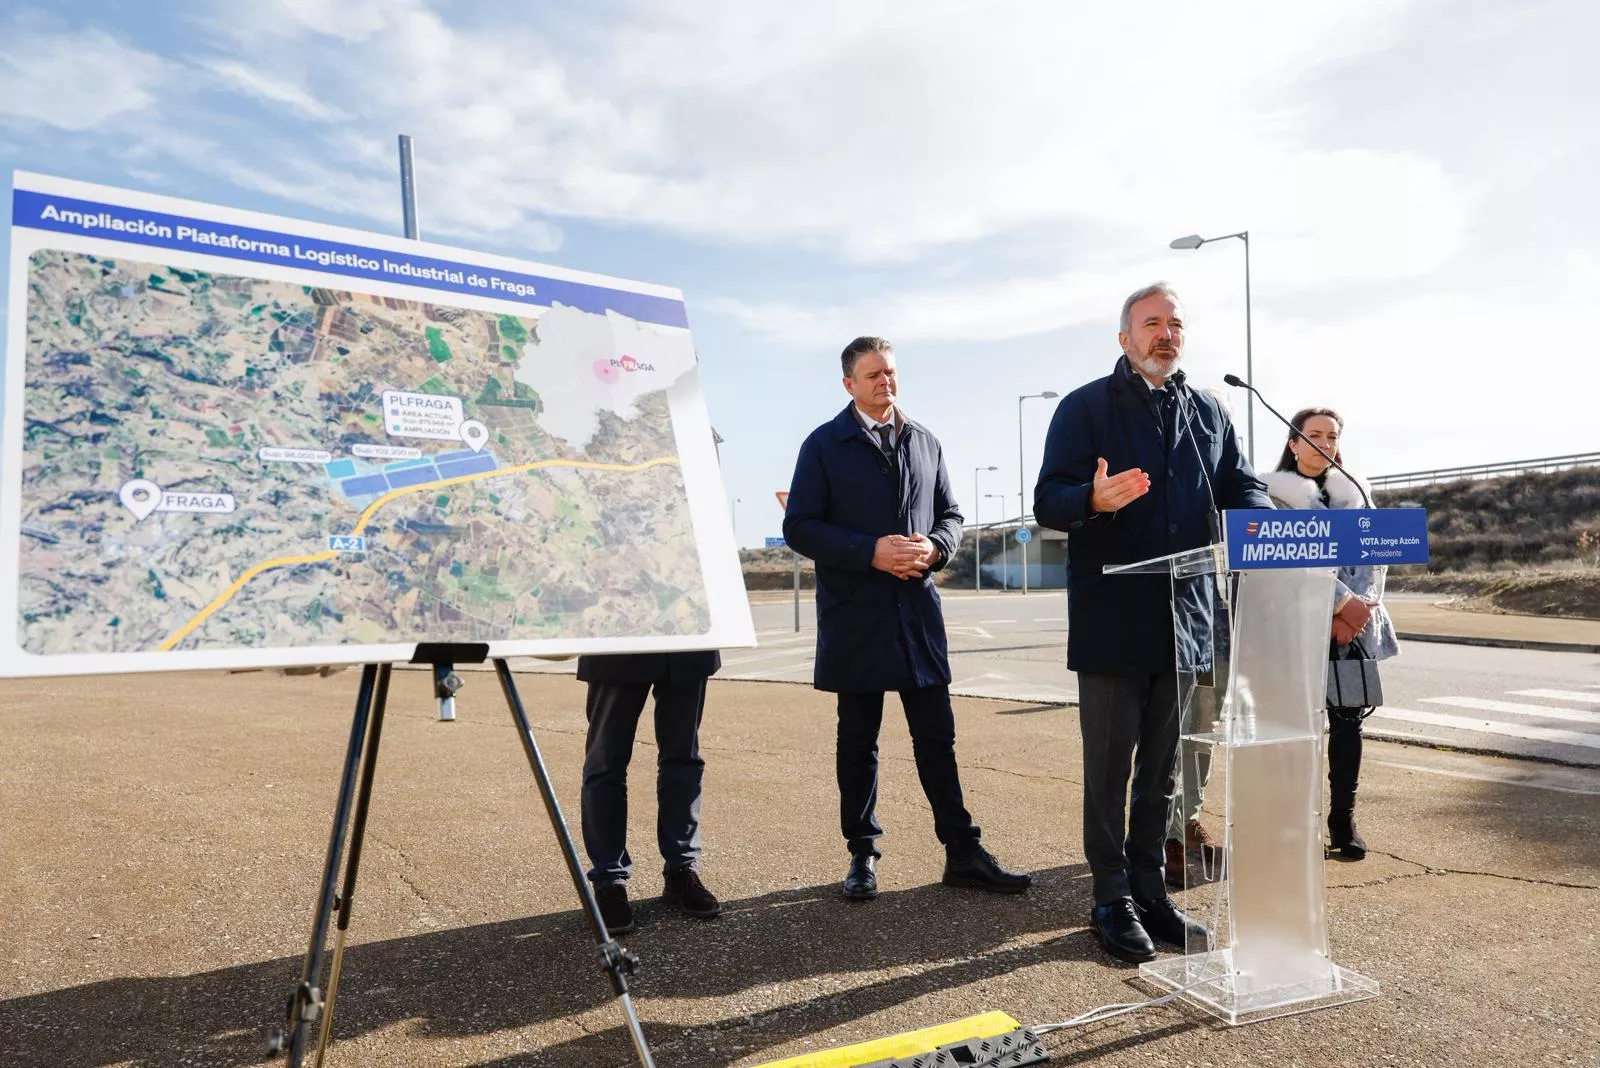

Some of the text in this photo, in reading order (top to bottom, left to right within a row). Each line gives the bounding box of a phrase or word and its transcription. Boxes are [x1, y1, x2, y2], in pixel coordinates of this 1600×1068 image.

[40, 204, 536, 297] Ampliación Plataforma Logístico Industrial de Fraga
[390, 395, 453, 410] PLFRAGA
[166, 495, 226, 509] FRAGA
[1258, 515, 1331, 539] ARAGÓN
[332, 537, 360, 550] A-2
[1360, 536, 1420, 547] VOTA Jorge Azcón
[1242, 542, 1338, 562] IMPARABLE
[1370, 549, 1402, 558] Presidente
